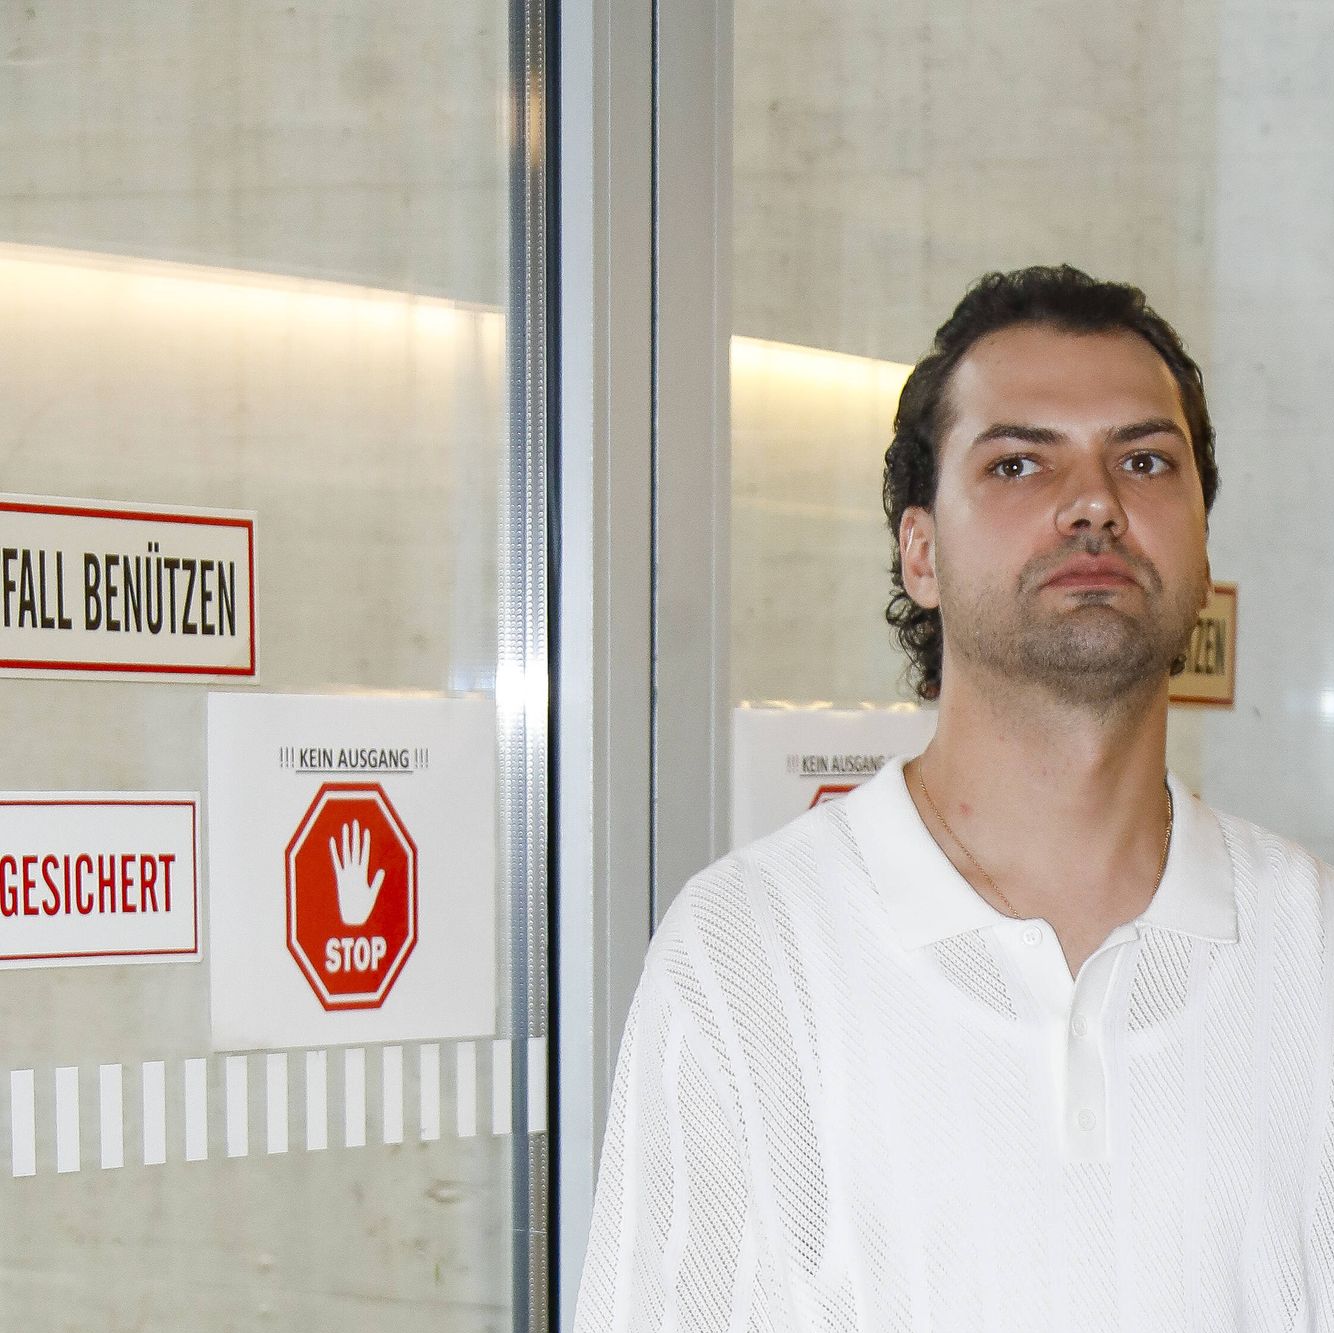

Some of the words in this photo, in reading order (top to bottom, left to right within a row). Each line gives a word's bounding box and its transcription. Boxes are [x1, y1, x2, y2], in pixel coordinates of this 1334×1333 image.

[3, 547, 72, 629] FALL
[84, 541, 236, 636] BENÜTZEN
[299, 748, 333, 768] KEIN
[337, 748, 410, 768] AUSGANG
[801, 754, 828, 772] KEIN
[0, 853, 176, 917] GESICHERT
[325, 936, 387, 972] STOP
